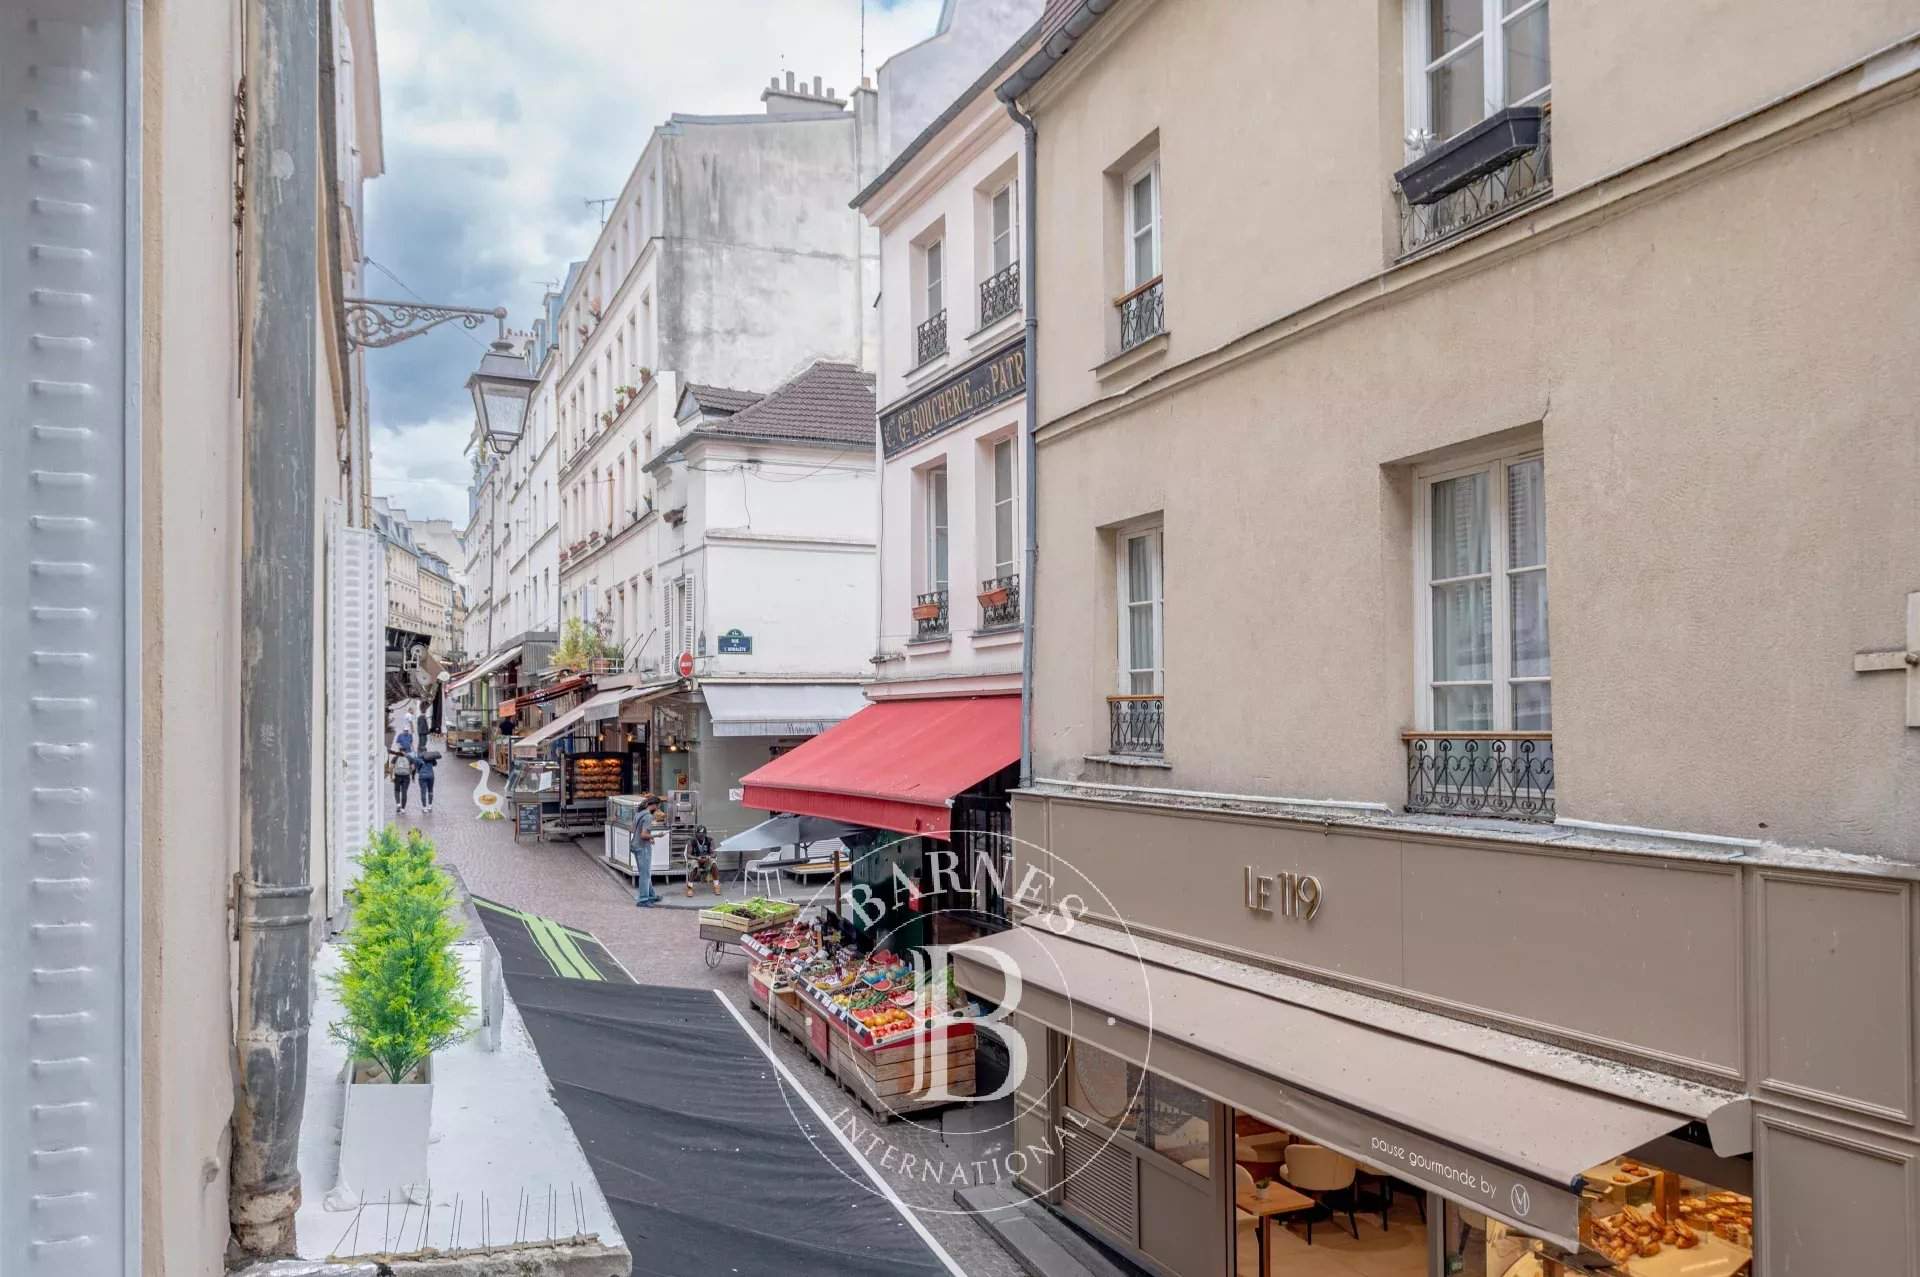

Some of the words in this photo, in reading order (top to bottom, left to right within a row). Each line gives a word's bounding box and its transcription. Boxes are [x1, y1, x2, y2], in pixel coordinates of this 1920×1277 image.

[911, 378, 973, 437] BOUCHERIE
[989, 350, 1026, 397] PATR
[1277, 871, 1322, 921] 119
[1371, 1136, 1406, 1160] pause
[1408, 1152, 1478, 1188] gourmande
[1480, 1175, 1498, 1199] by
